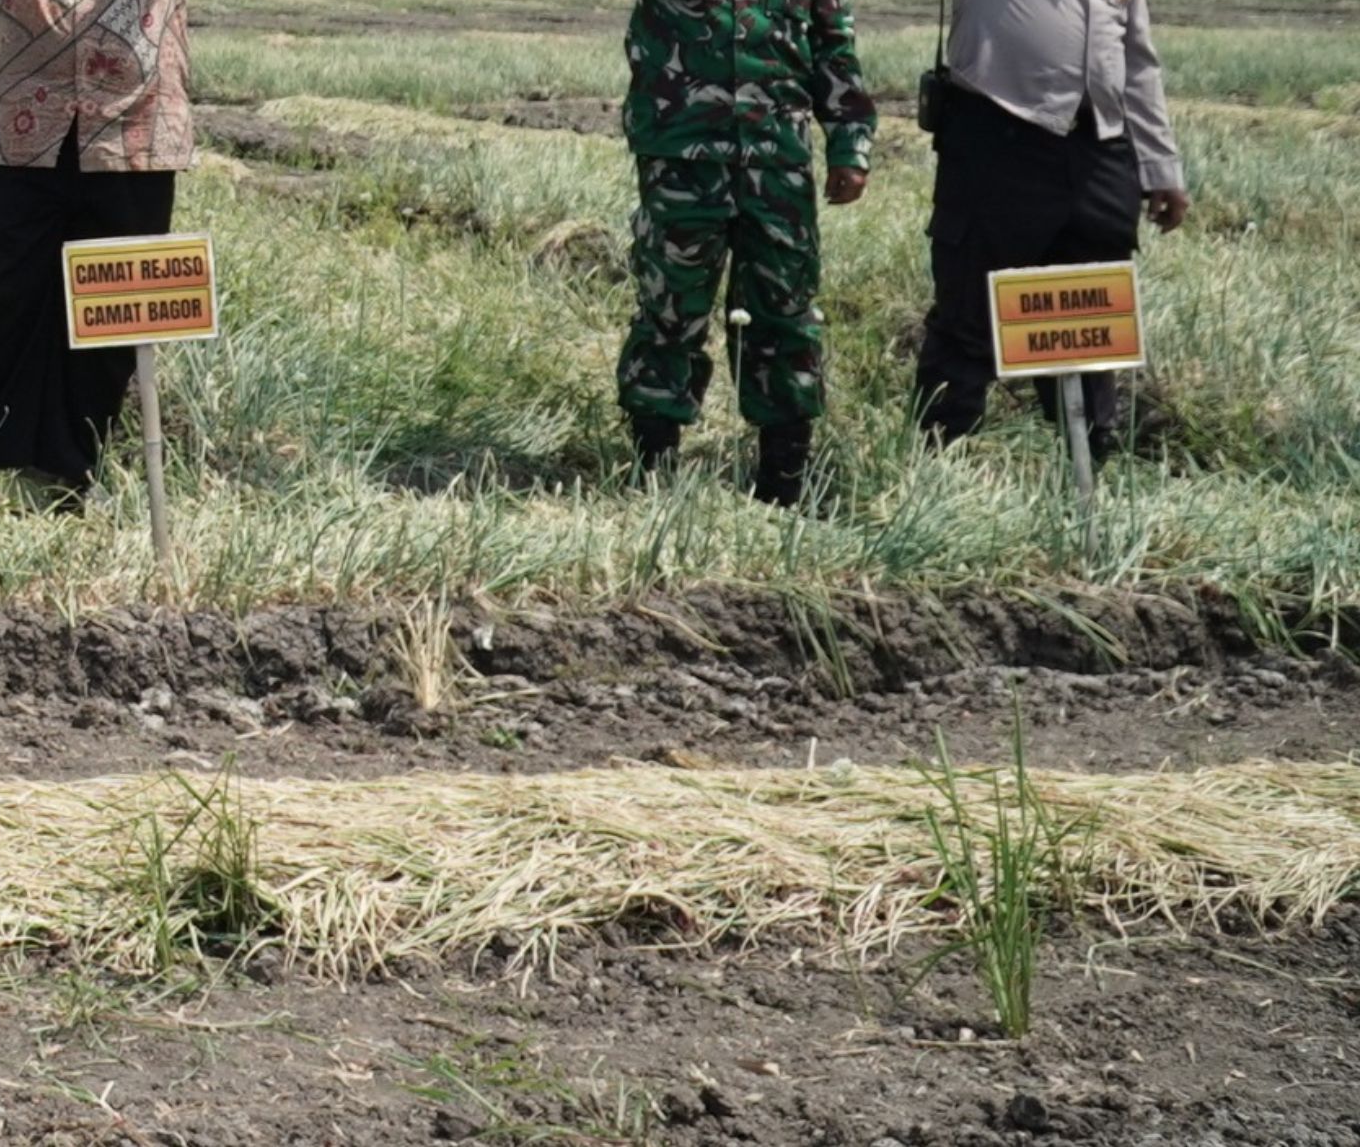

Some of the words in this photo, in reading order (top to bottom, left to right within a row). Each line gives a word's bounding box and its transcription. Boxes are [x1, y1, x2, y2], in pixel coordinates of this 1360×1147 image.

[75, 261, 135, 285] CAMAT
[140, 255, 204, 280] REJOSO
[83, 303, 142, 327] CAMAT
[147, 298, 203, 322] BAGOR
[1019, 291, 1054, 314] DAN
[1058, 287, 1114, 310] RAMIL
[1027, 326, 1113, 352] KAPOLSEK
